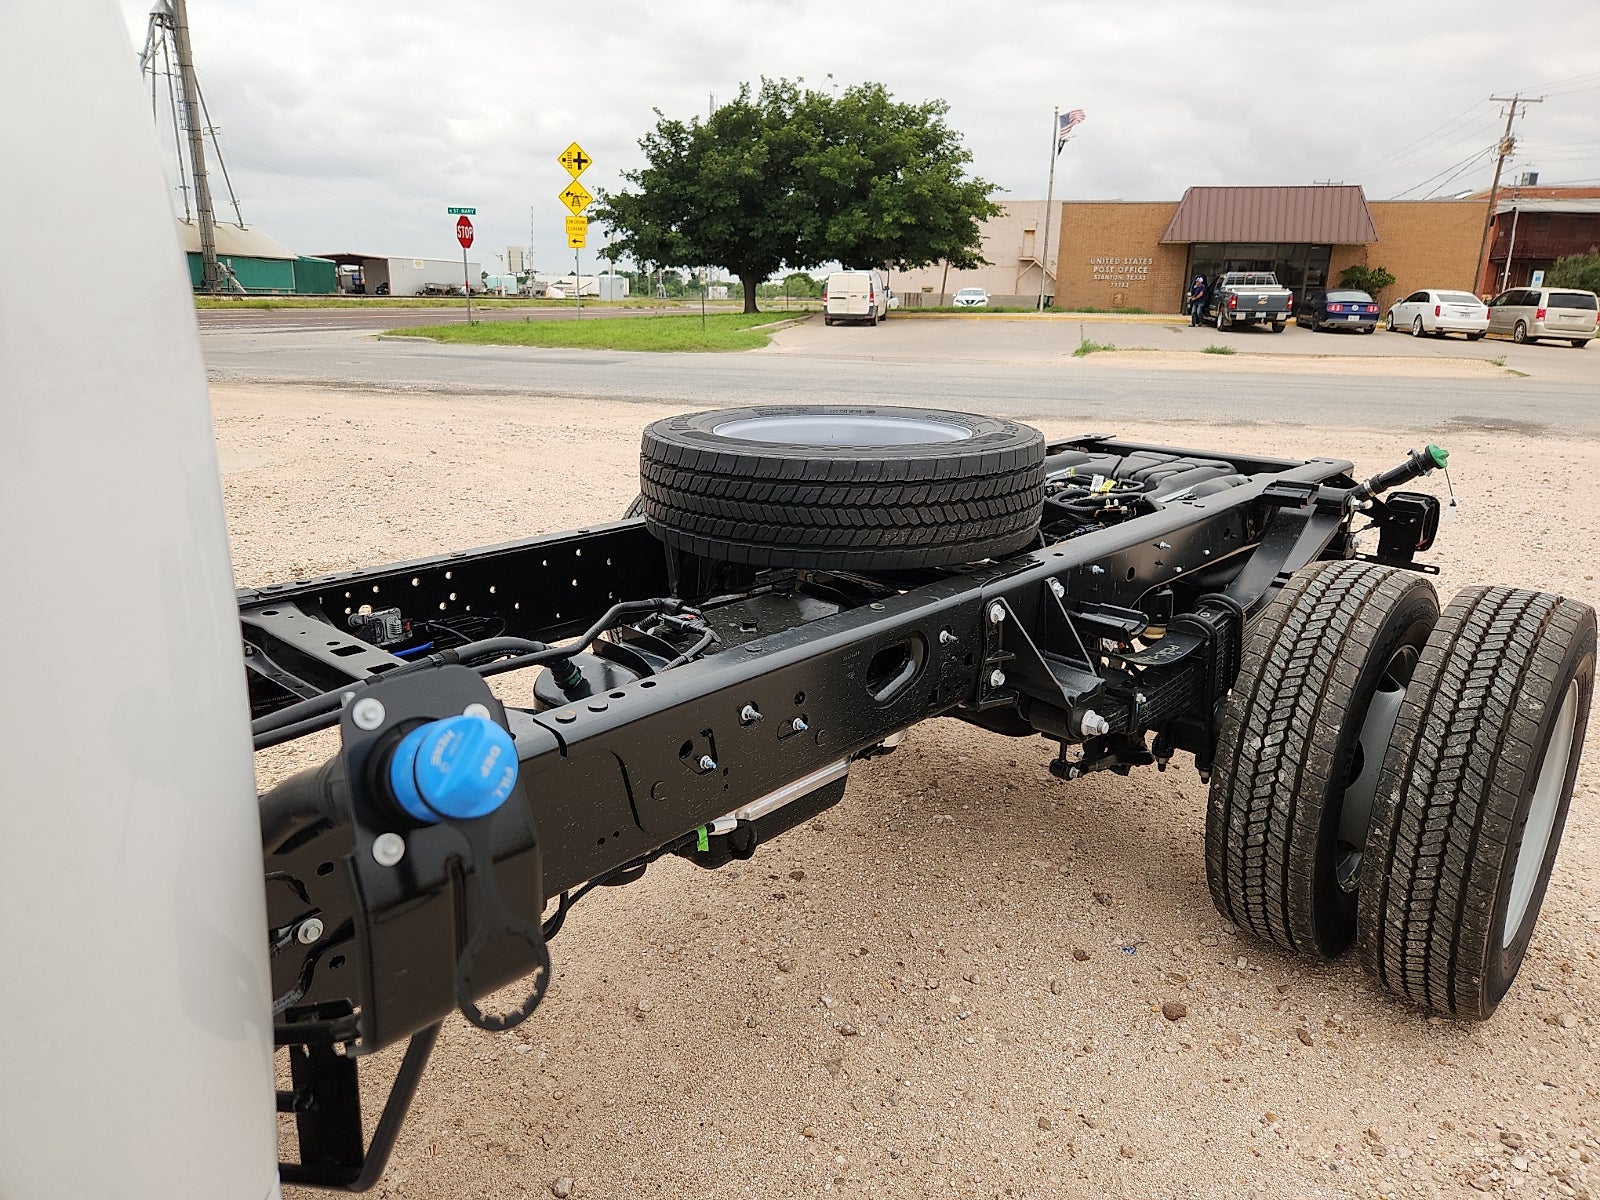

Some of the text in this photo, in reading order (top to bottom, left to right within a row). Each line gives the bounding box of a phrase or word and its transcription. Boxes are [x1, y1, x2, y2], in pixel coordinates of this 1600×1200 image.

[457, 225, 473, 239] STOP
[1090, 257, 1153, 265] UNITED STATES
[1117, 266, 1149, 274] OFFICE
[480, 744, 502, 779] DEF
[491, 766, 514, 798] FILL
